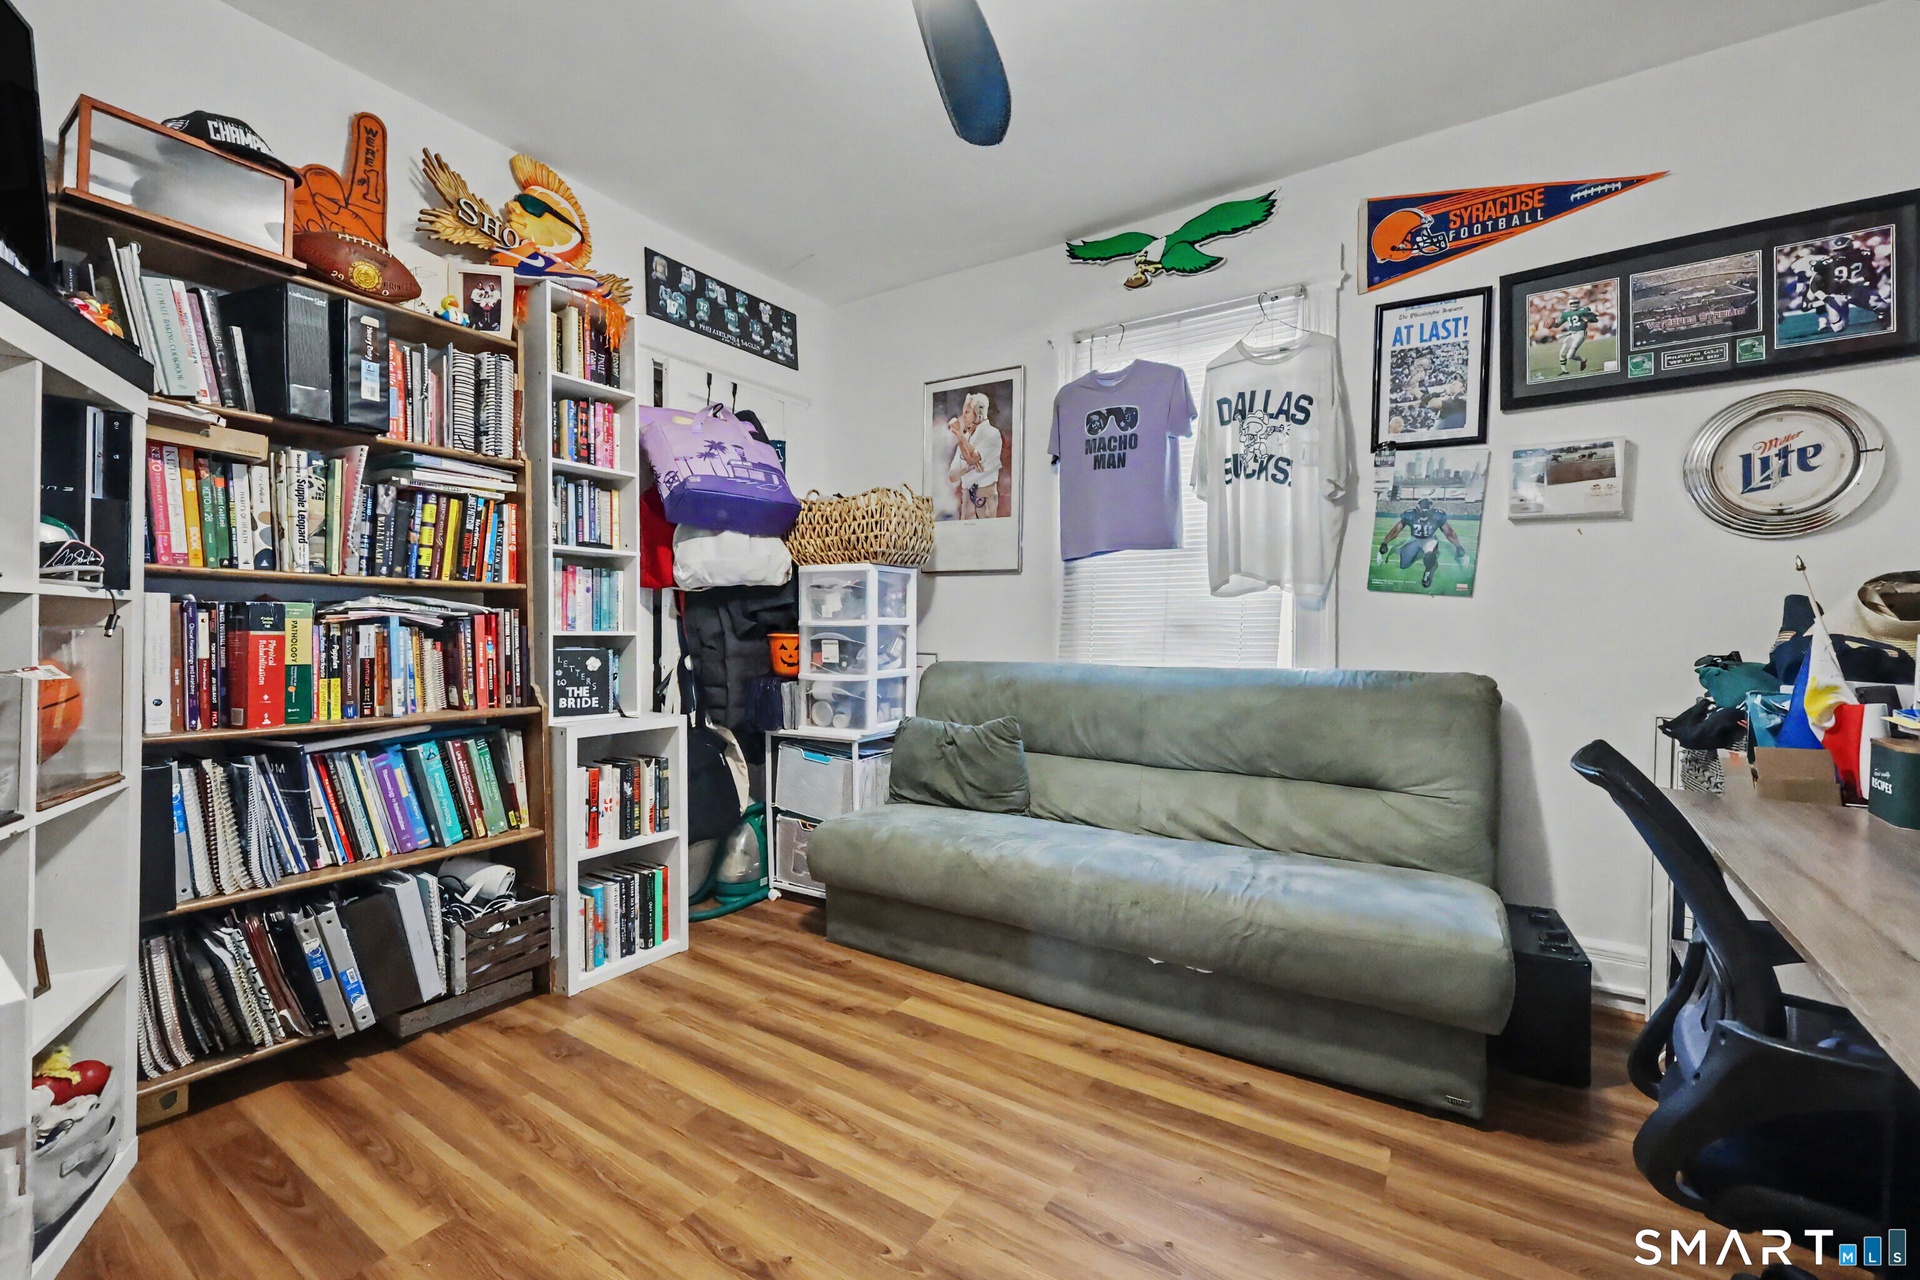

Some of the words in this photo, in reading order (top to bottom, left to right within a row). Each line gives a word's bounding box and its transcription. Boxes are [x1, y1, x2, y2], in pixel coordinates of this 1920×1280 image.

[1449, 187, 1545, 229] SYRACUSE
[458, 198, 521, 249] SHO
[1449, 208, 1544, 241] FOOTBALL
[1391, 324, 1414, 347] AT
[1419, 316, 1469, 344] LAST!
[1216, 389, 1314, 426] DALLAS
[1084, 433, 1139, 455] MACHO
[1753, 430, 1804, 455] Miller
[165, 450, 177, 481] KETO
[1093, 452, 1126, 470] MAN
[1739, 443, 1825, 495] Lite
[202, 486, 211, 505] KETO
[294, 478, 307, 508] Supple
[204, 512, 213, 522] 28
[296, 509, 308, 544] Leopard
[377, 516, 385, 540] WALLY
[258, 639, 268, 685] Rehabilitation
[267, 639, 277, 666] Physical
[557, 656, 597, 690] LETTERS
[558, 697, 604, 709] BRIDE.
[566, 686, 590, 698] THE
[1871, 776, 1893, 795] RECIPES
